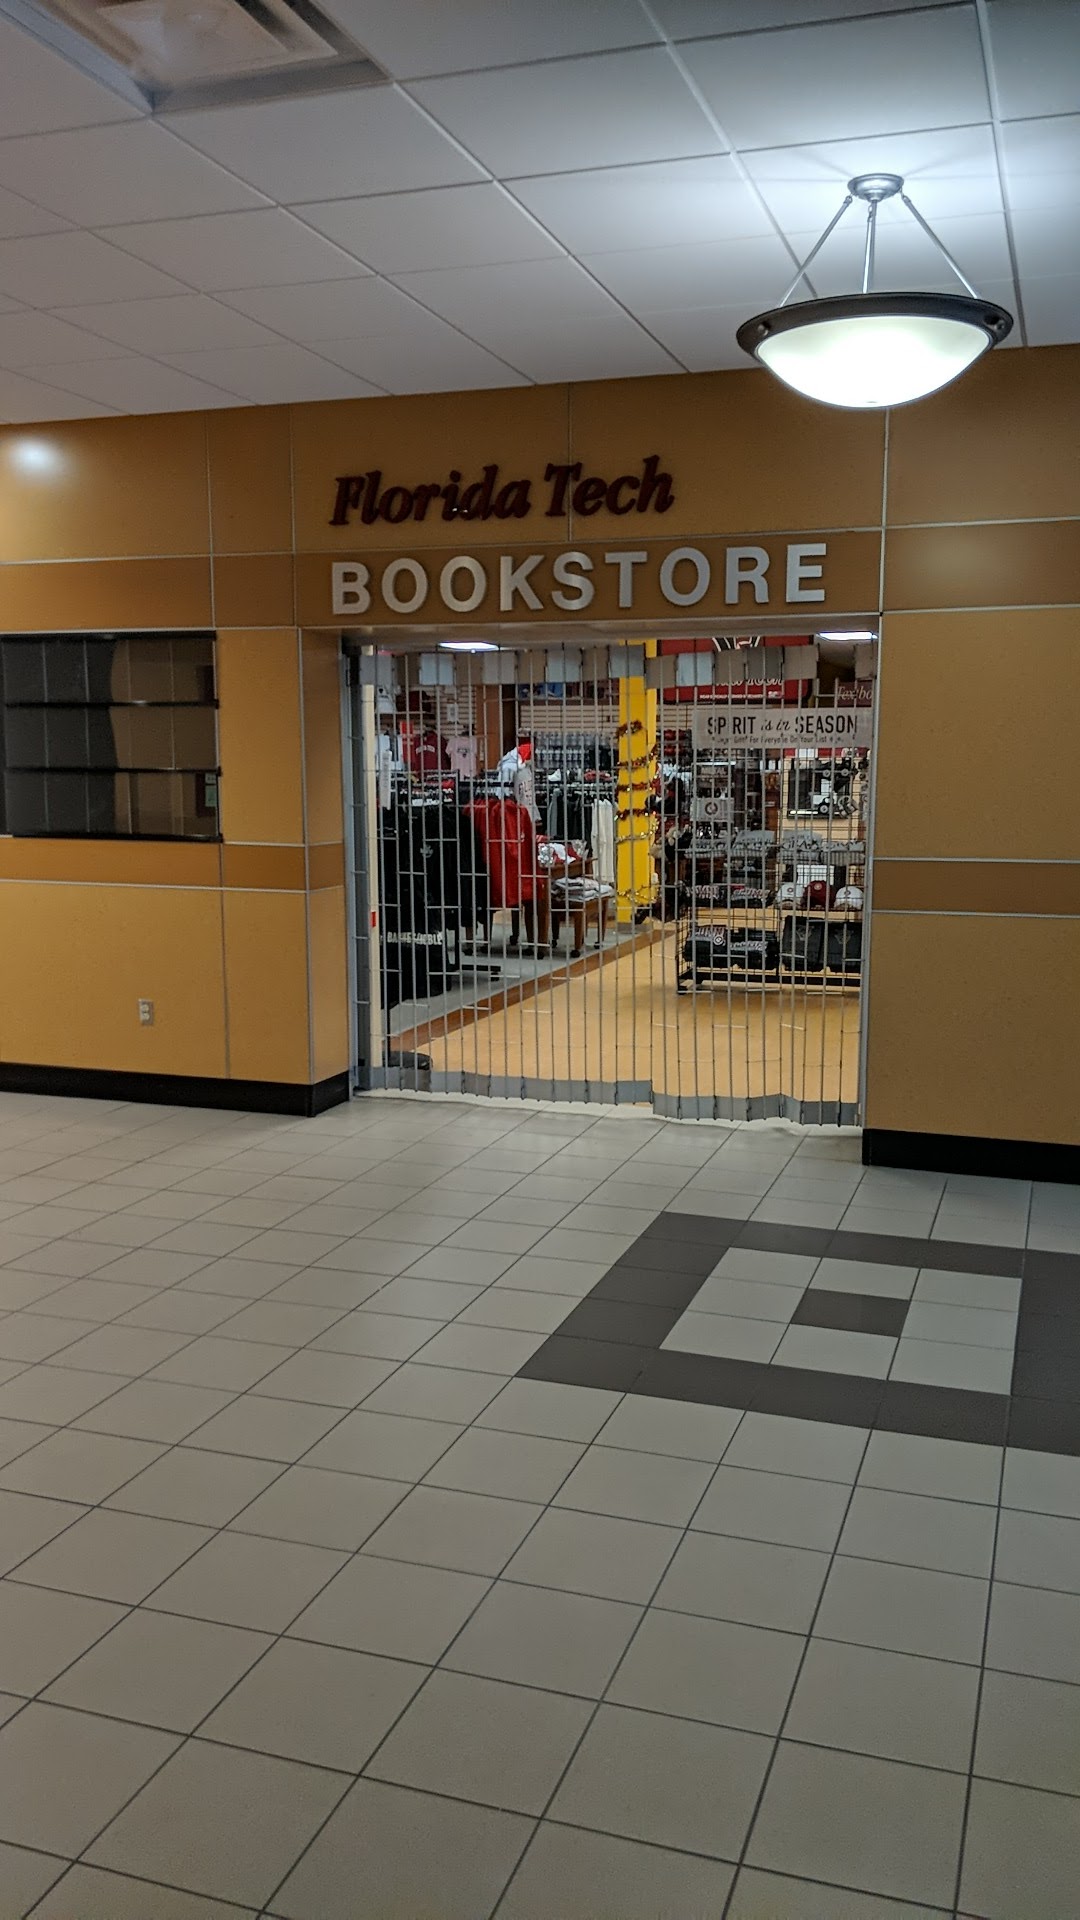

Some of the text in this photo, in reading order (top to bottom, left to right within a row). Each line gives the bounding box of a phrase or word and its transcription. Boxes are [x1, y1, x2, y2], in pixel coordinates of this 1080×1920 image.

[329, 455, 675, 525] Florida Tech
[331, 543, 827, 615] BOOKSTORE
[838, 686, 872, 700] Texbo
[707, 716, 756, 735] SPRIT
[795, 715, 857, 735] SEASON
